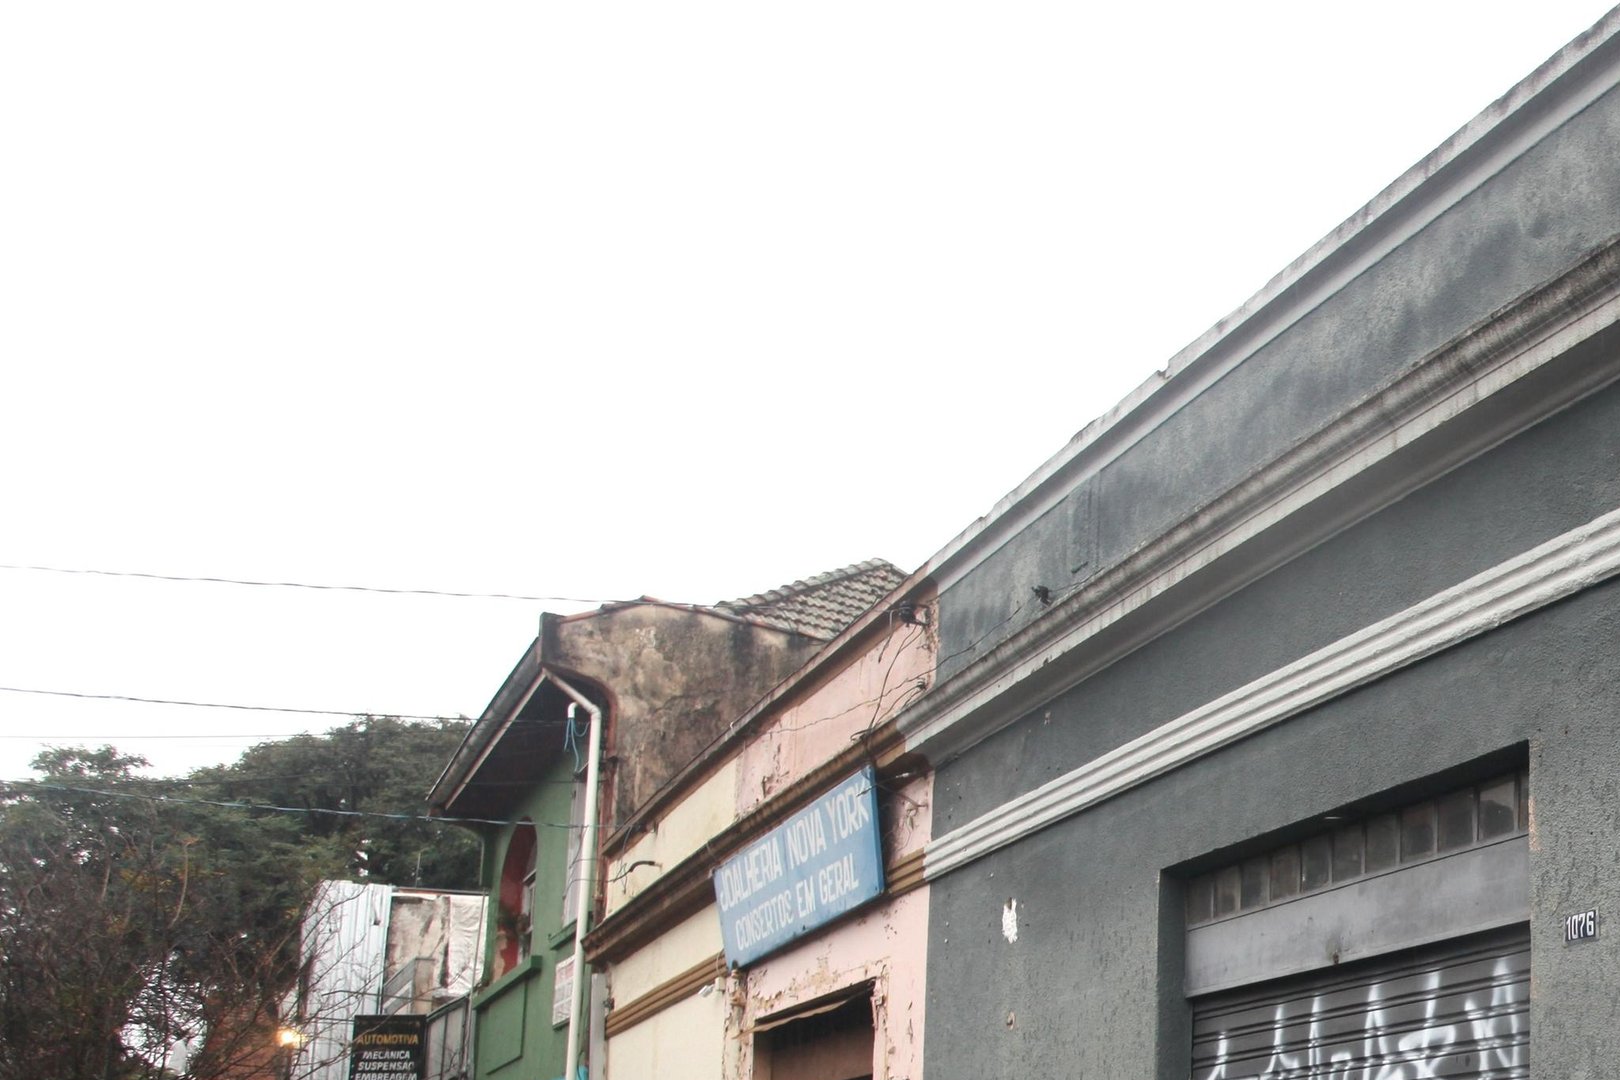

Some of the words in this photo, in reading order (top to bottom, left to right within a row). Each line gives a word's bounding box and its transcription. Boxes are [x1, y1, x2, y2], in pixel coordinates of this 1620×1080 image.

[720, 836, 783, 912] JOALHERIA
[787, 807, 826, 870] NOVA
[825, 777, 870, 845] YORK
[735, 890, 794, 951] CONSERTOS
[795, 875, 816, 918] EM
[818, 853, 860, 905] GERAL
[1566, 911, 1594, 941] 1076
[357, 1034, 419, 1045] AUTOMOTIVA
